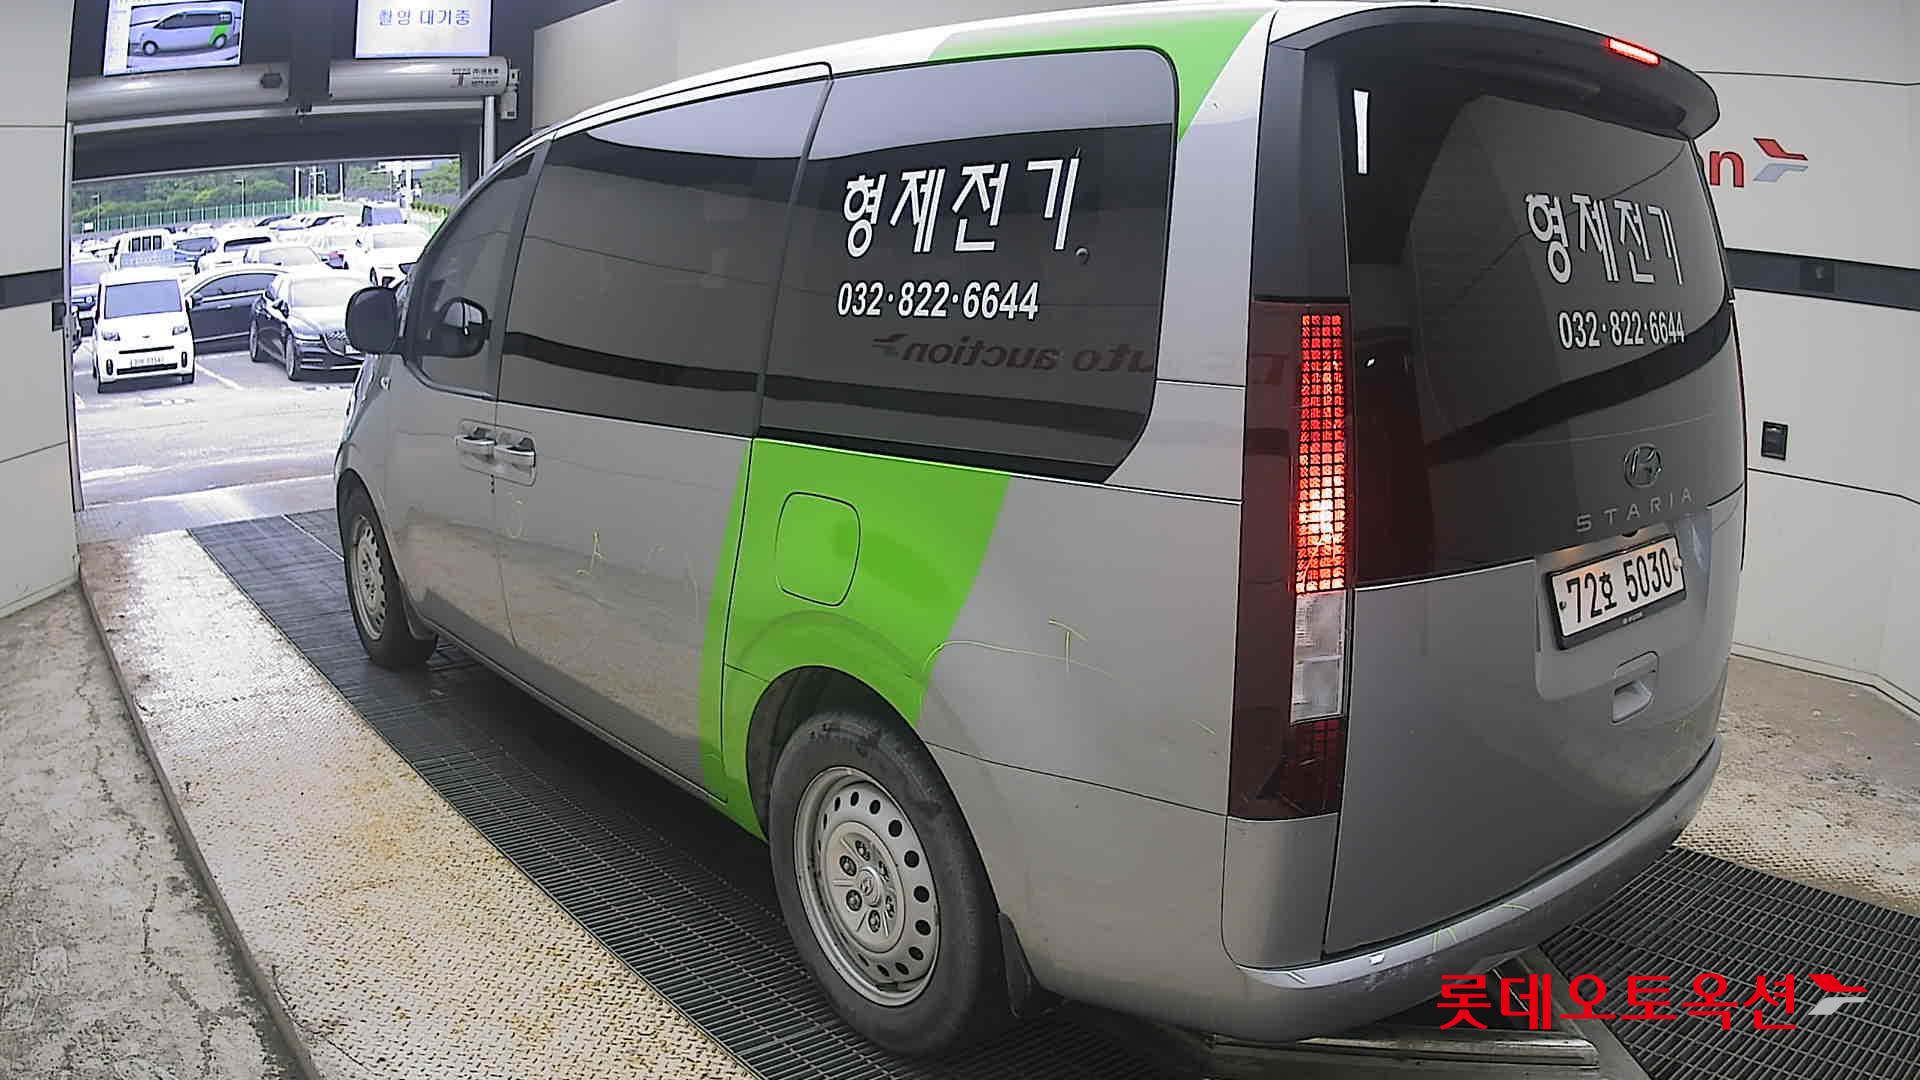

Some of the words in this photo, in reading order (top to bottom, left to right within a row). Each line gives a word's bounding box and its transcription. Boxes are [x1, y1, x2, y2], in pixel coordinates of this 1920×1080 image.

[419, 8, 471, 26] 대기중
[843, 157, 1080, 258] 형제전기
[1524, 193, 1684, 285] 형제전기
[1576, 487, 1693, 533] STARIA
[1566, 571, 1618, 624] 72호
[1623, 547, 1674, 603] 5030
